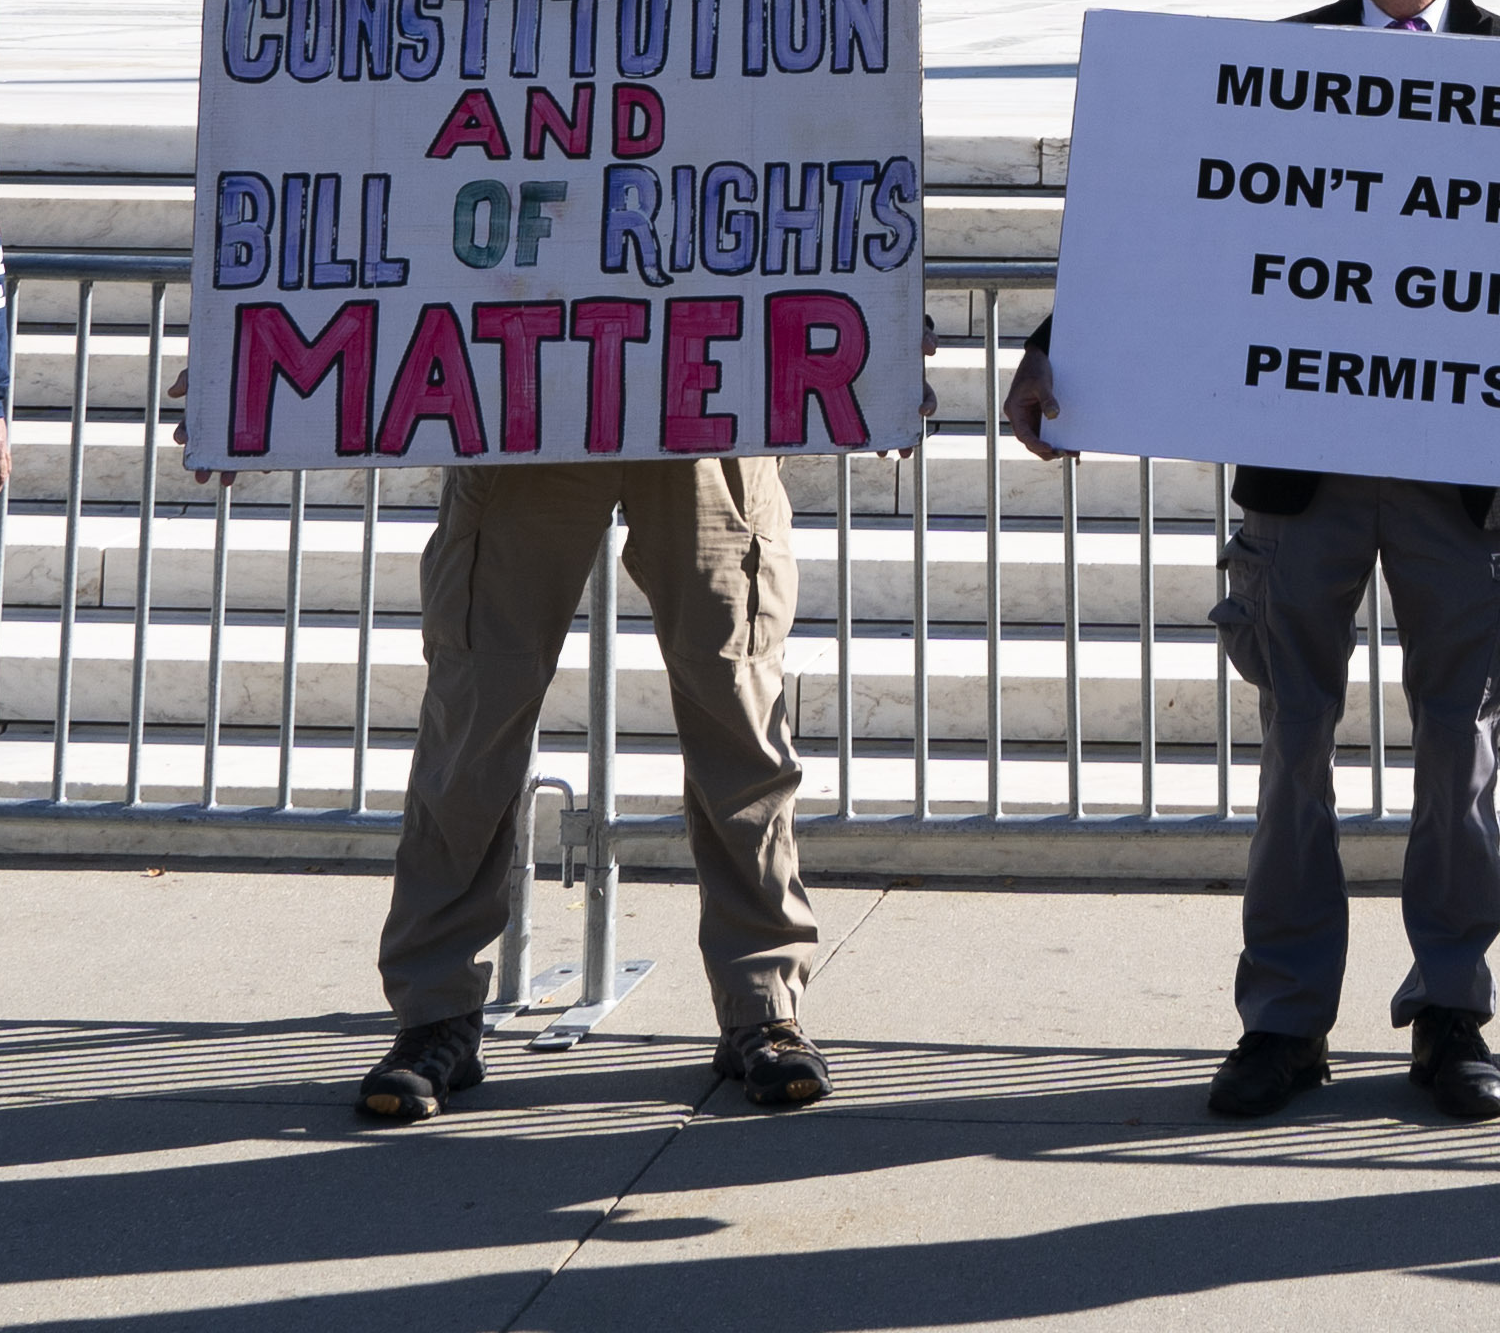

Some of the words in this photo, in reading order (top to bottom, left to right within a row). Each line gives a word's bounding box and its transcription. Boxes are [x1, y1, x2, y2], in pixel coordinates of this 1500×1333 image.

[425, 82, 666, 161] AND
[213, 170, 410, 291] BILL
[452, 179, 568, 269] OF
[600, 155, 918, 288] RIGHTS
[1196, 157, 1383, 214] DON'T
[1250, 253, 1374, 305] FOR
[227, 289, 872, 459] MATTER
